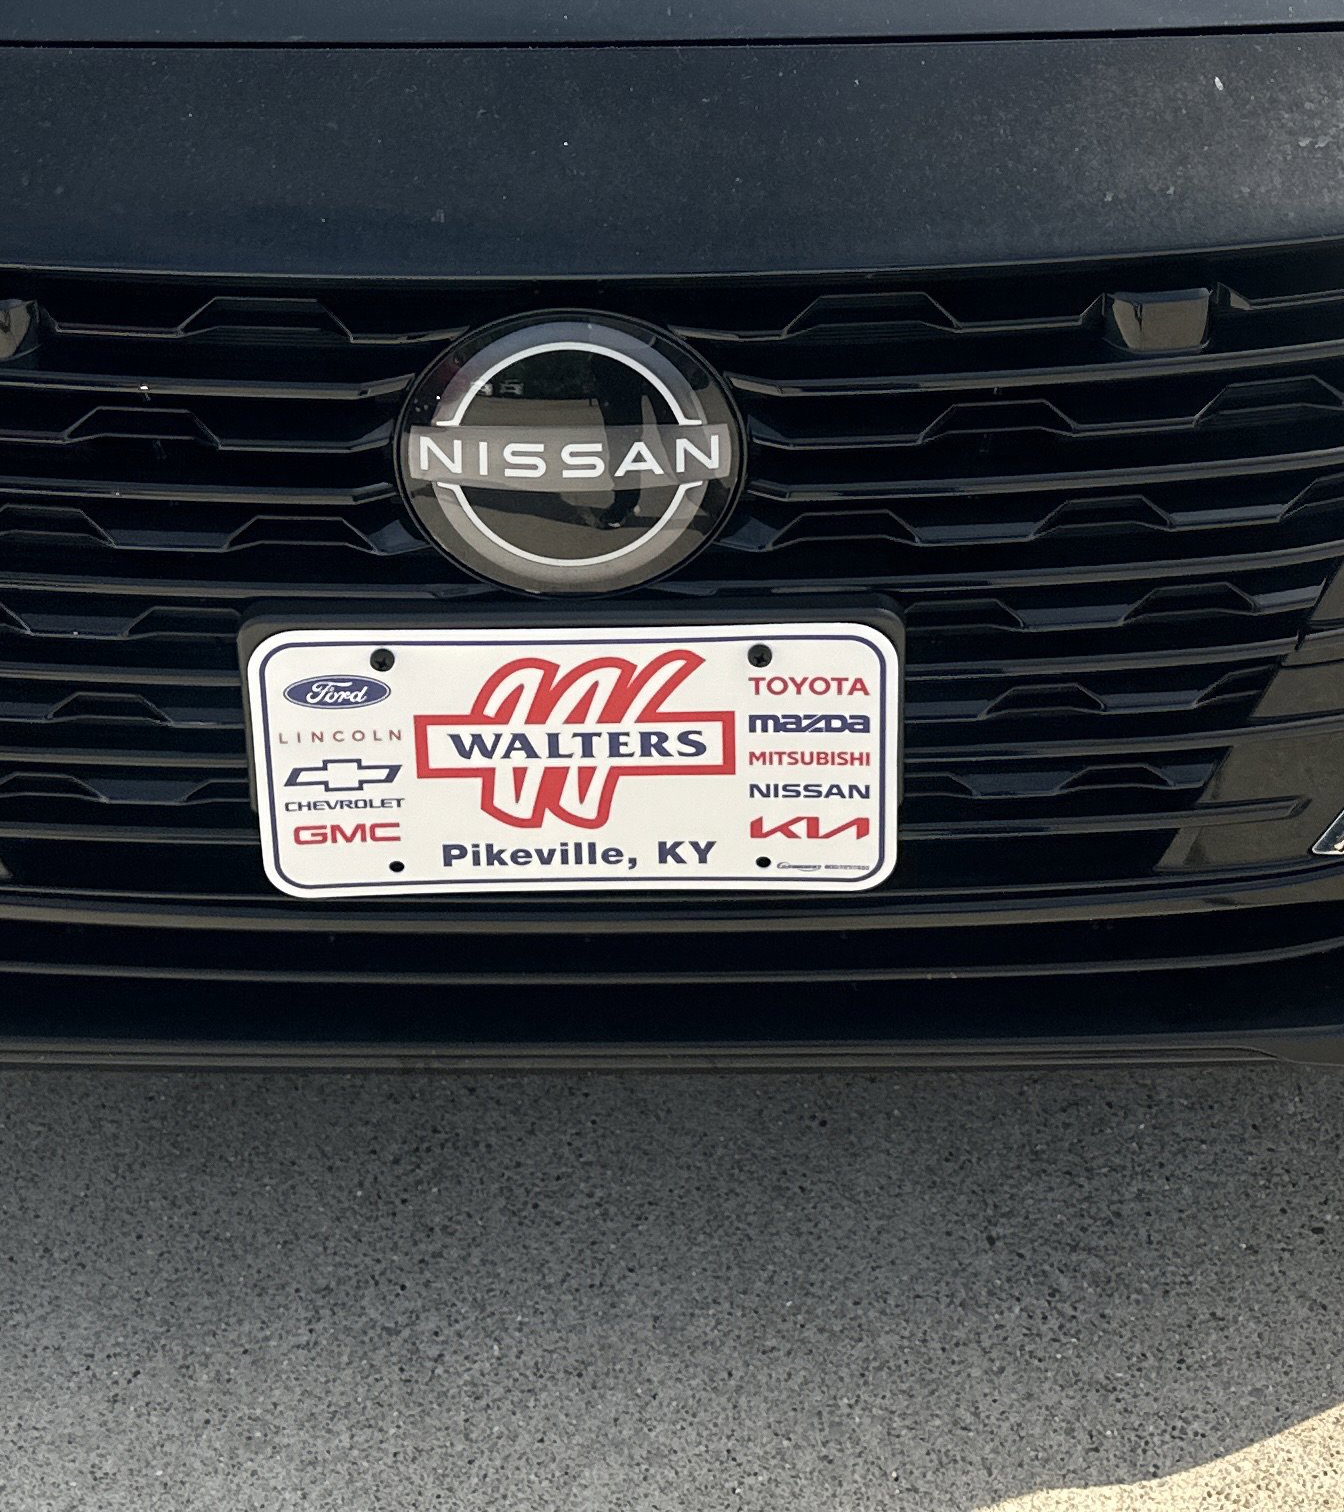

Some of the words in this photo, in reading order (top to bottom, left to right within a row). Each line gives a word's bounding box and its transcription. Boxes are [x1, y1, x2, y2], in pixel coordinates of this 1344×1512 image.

[419, 435, 719, 478] NISSAN
[305, 681, 368, 704] Ford
[748, 677, 871, 696] TOYOTA
[278, 729, 402, 744] LINCOLN
[448, 730, 707, 760] WALTERS
[748, 750, 871, 767] MITSUBISHI
[749, 783, 871, 800] NISSAN
[284, 797, 406, 812] CHEVROLET
[293, 822, 402, 846] GMC
[442, 841, 638, 871] Pikeville,
[657, 840, 717, 865] KY
